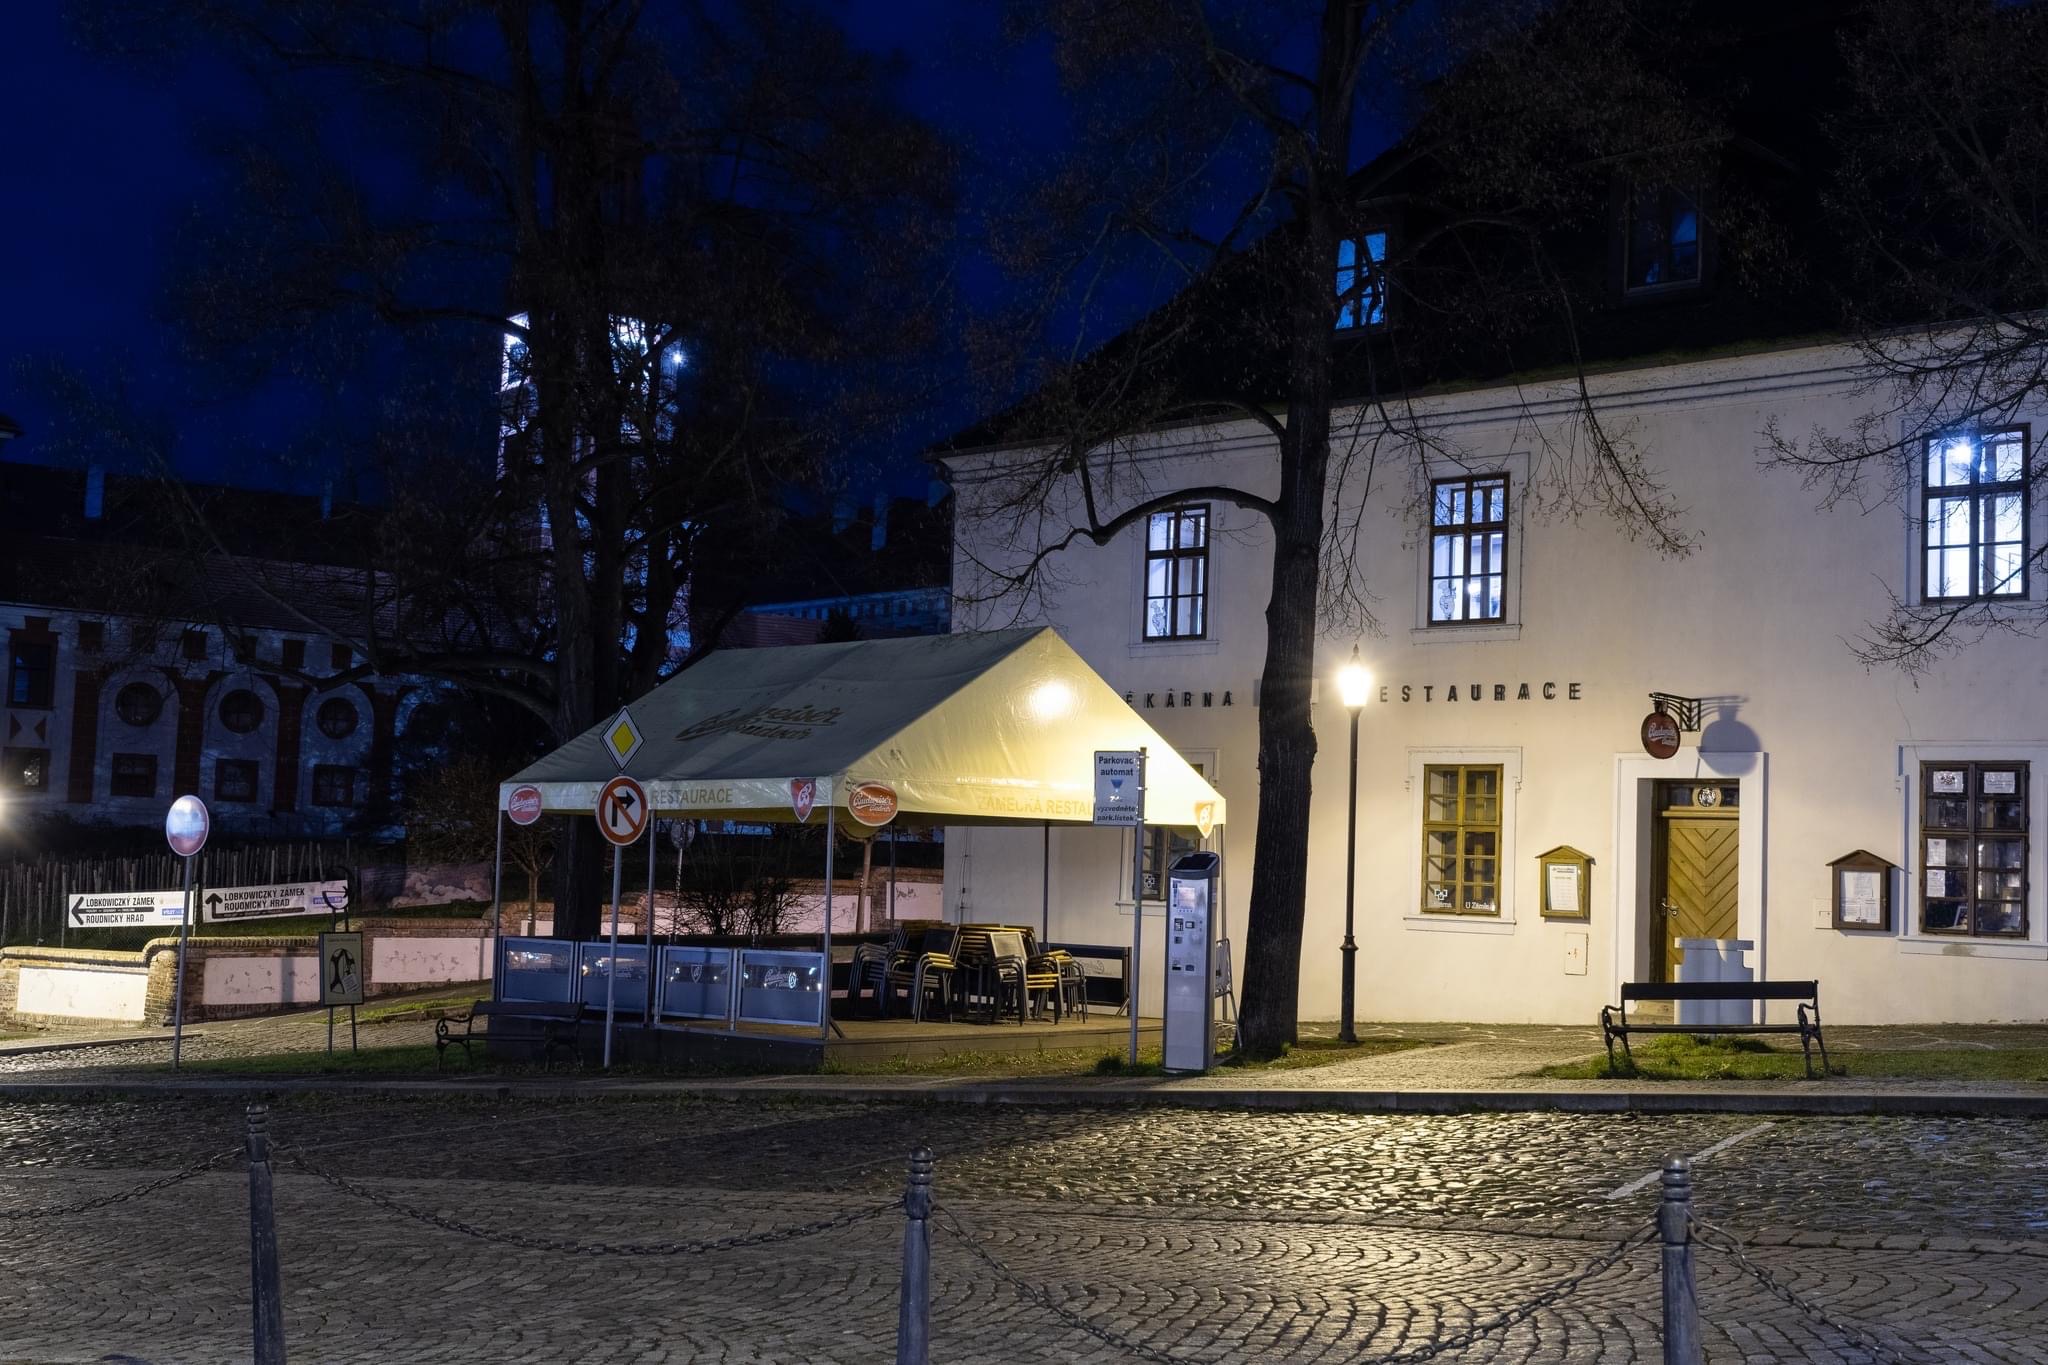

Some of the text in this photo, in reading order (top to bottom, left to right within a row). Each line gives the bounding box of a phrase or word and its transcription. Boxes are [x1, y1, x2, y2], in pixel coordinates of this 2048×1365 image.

[1379, 682, 1582, 703] ESTAURACE
[1125, 688, 1234, 709] ÉKÁRNA
[1098, 756, 1134, 765] Parkovac
[1100, 768, 1134, 776] automat
[653, 788, 734, 804] RESTAURACE
[270, 898, 290, 908] HRAD
[126, 913, 145, 923] HRAD
